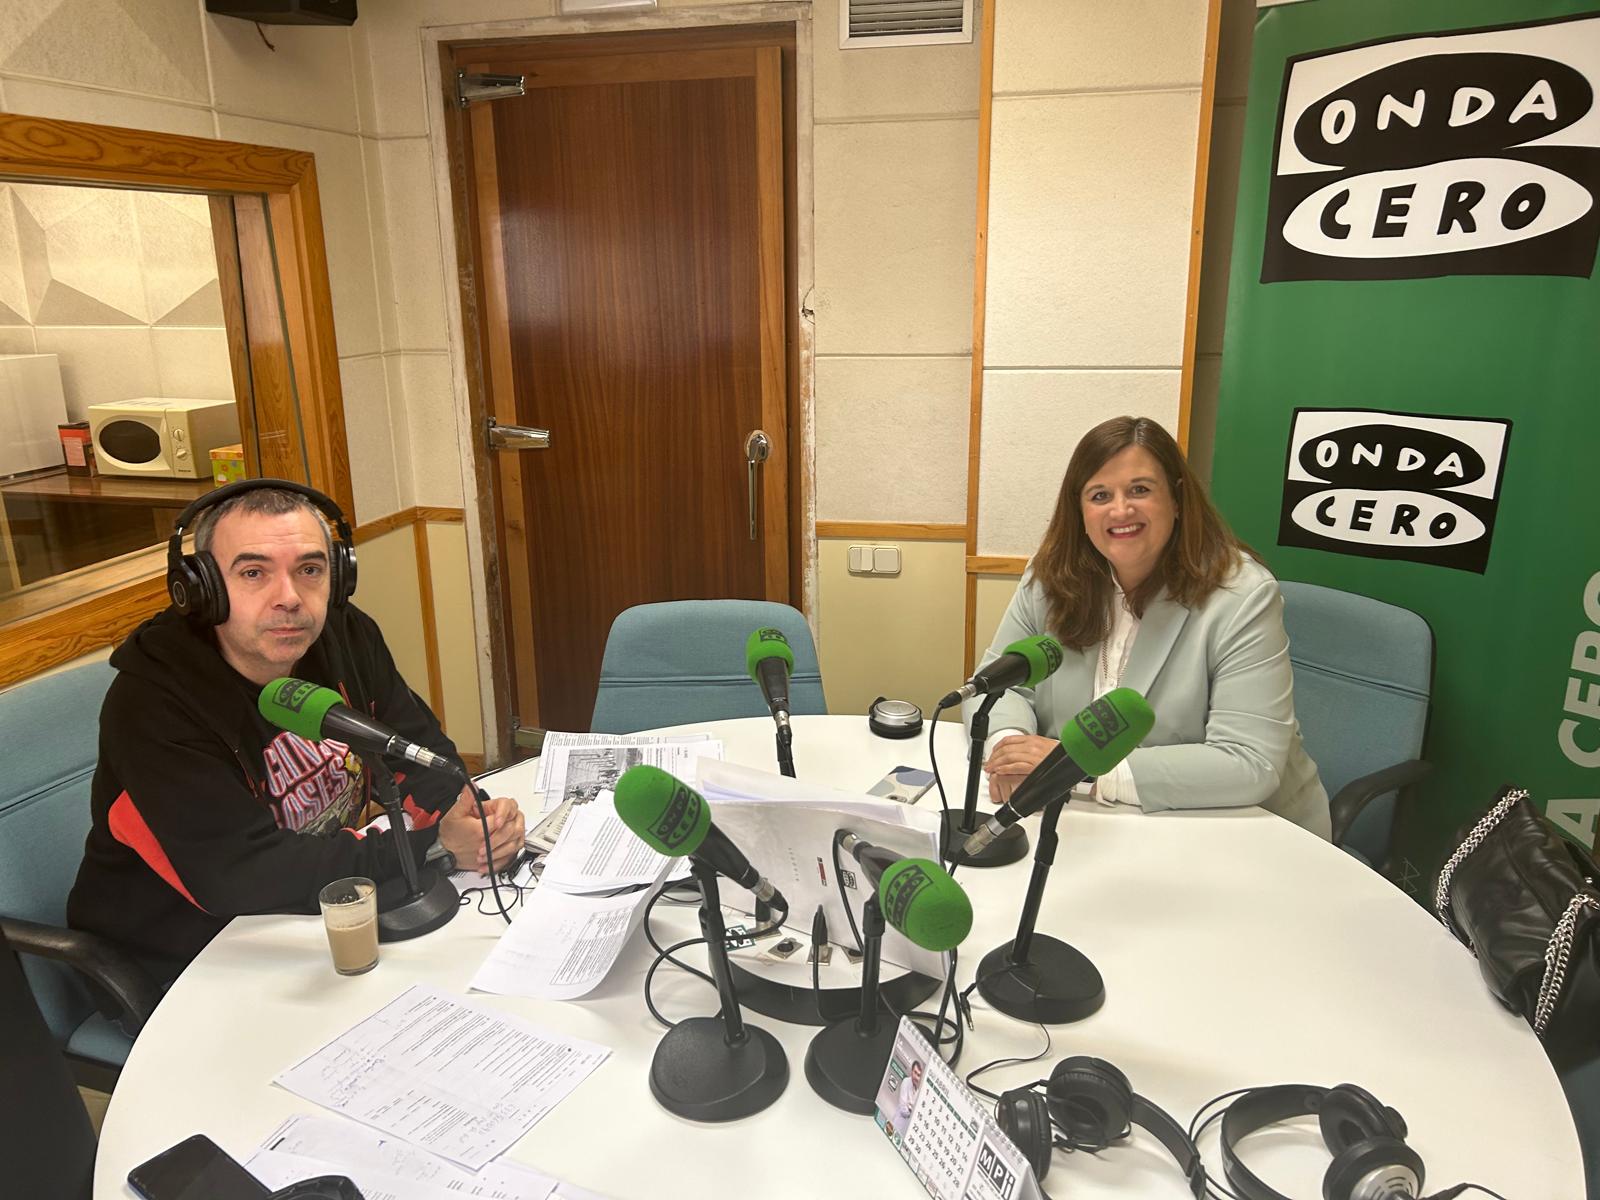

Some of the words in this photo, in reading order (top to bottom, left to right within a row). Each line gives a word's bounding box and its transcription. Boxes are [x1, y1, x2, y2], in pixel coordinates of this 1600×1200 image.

[1320, 79, 1558, 145] ONDA
[1320, 180, 1547, 240] CERO
[1315, 439, 1465, 479] ONDA
[1315, 495, 1458, 539] CERO
[269, 755, 348, 832] OSES
